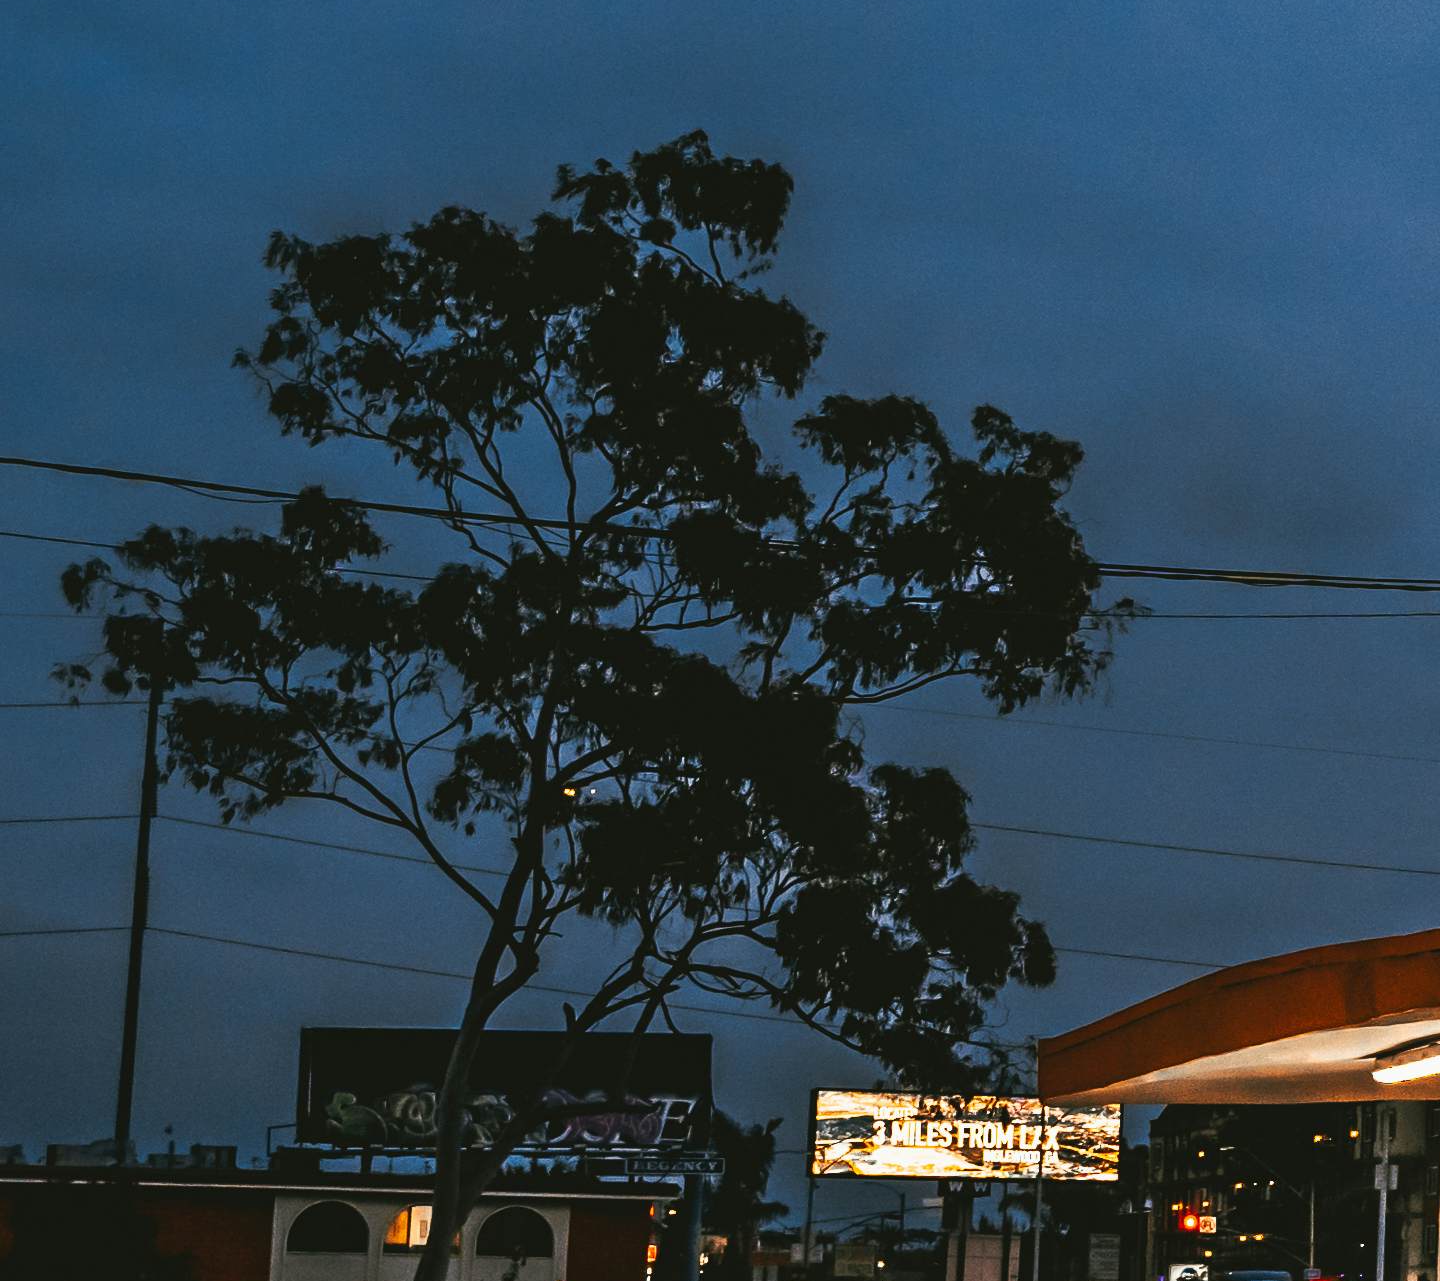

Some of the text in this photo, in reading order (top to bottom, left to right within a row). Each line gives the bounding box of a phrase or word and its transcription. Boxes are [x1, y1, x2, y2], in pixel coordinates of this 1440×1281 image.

[873, 1120, 1060, 1150] 3 MILES FROM LAX
